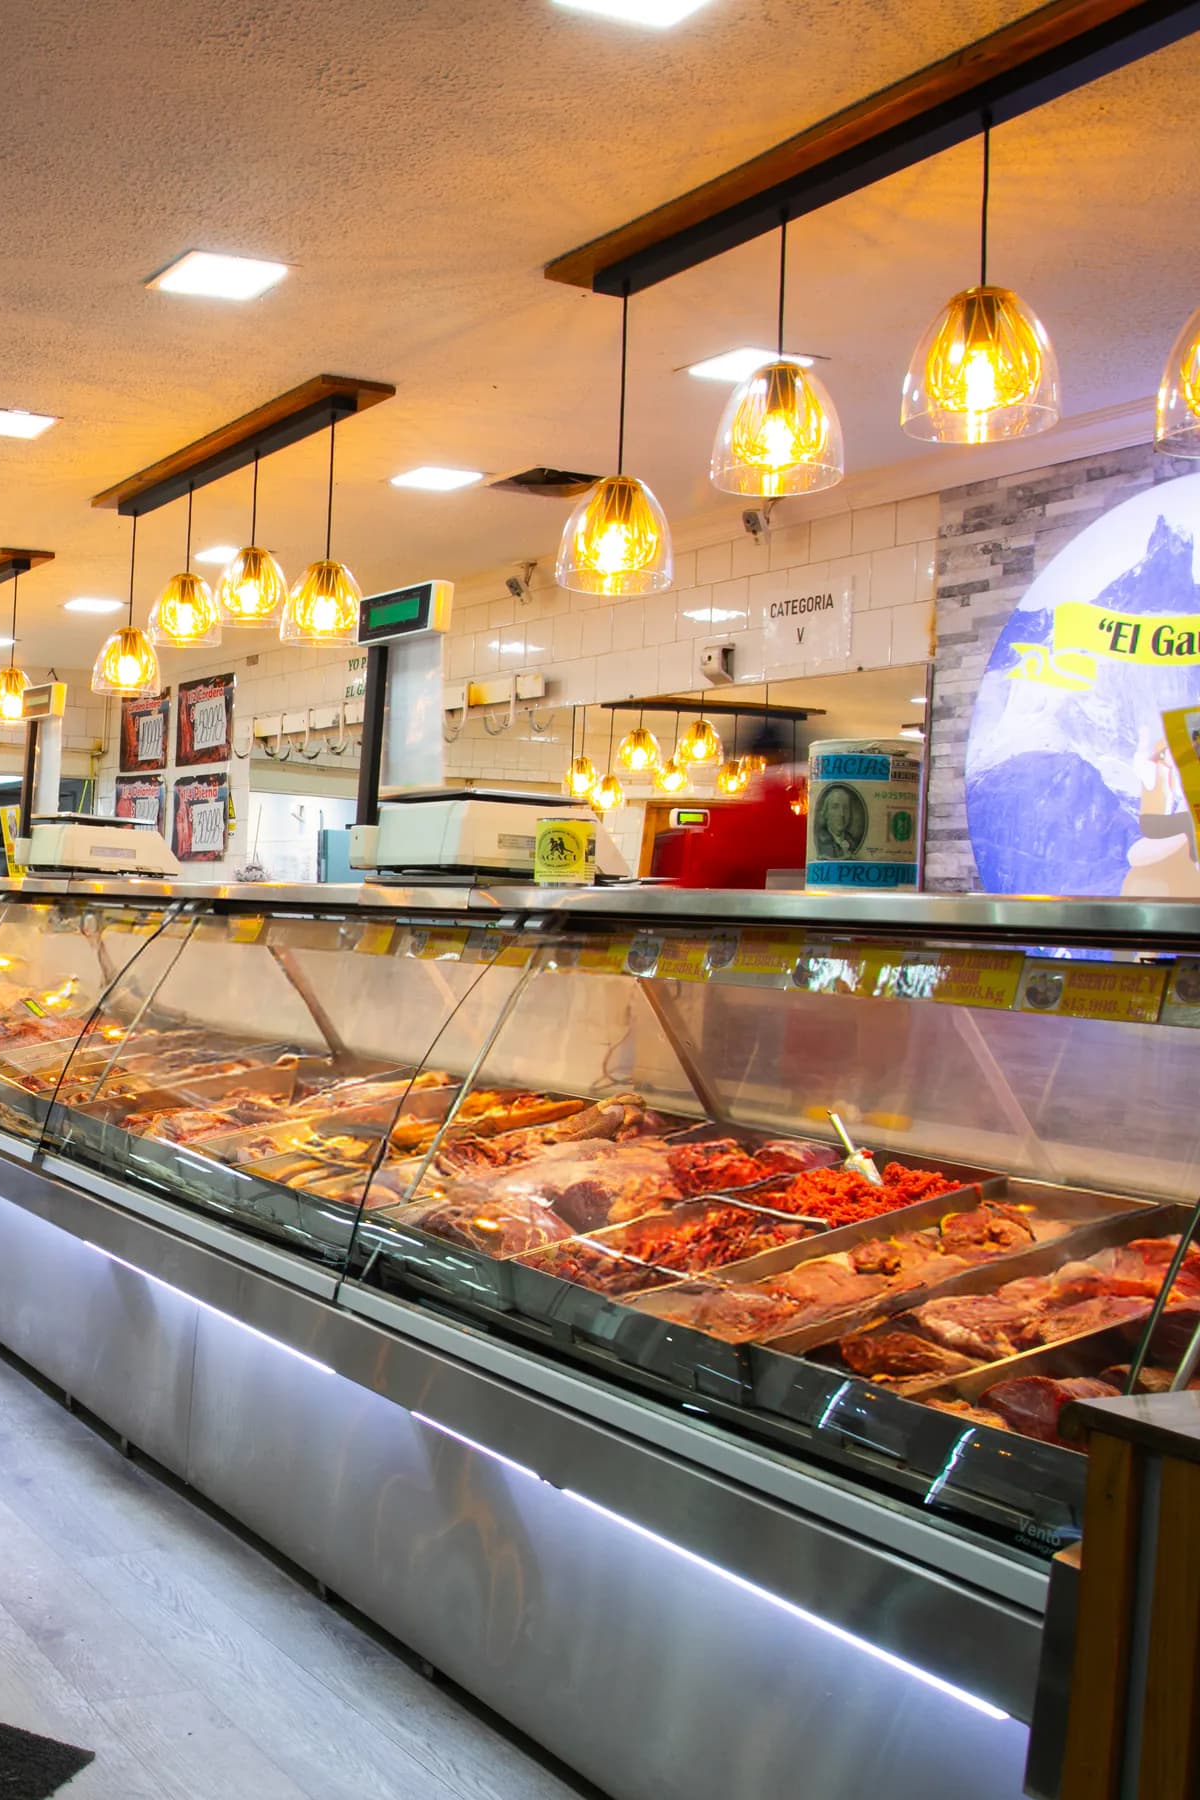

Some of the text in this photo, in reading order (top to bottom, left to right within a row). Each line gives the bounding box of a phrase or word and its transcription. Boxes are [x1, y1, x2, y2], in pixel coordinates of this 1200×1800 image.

[770, 593, 834, 618] CATEGORIA
[797, 627, 804, 642] V
[1151, 625, 1200, 656] Ga
[348, 658, 359, 671] YO
[198, 686, 224, 701] Cordero
[345, 686, 354, 698] EL
[194, 785, 218, 798] Pierna
[812, 867, 830, 882] SU
[1019, 1518, 1060, 1546] Vento
